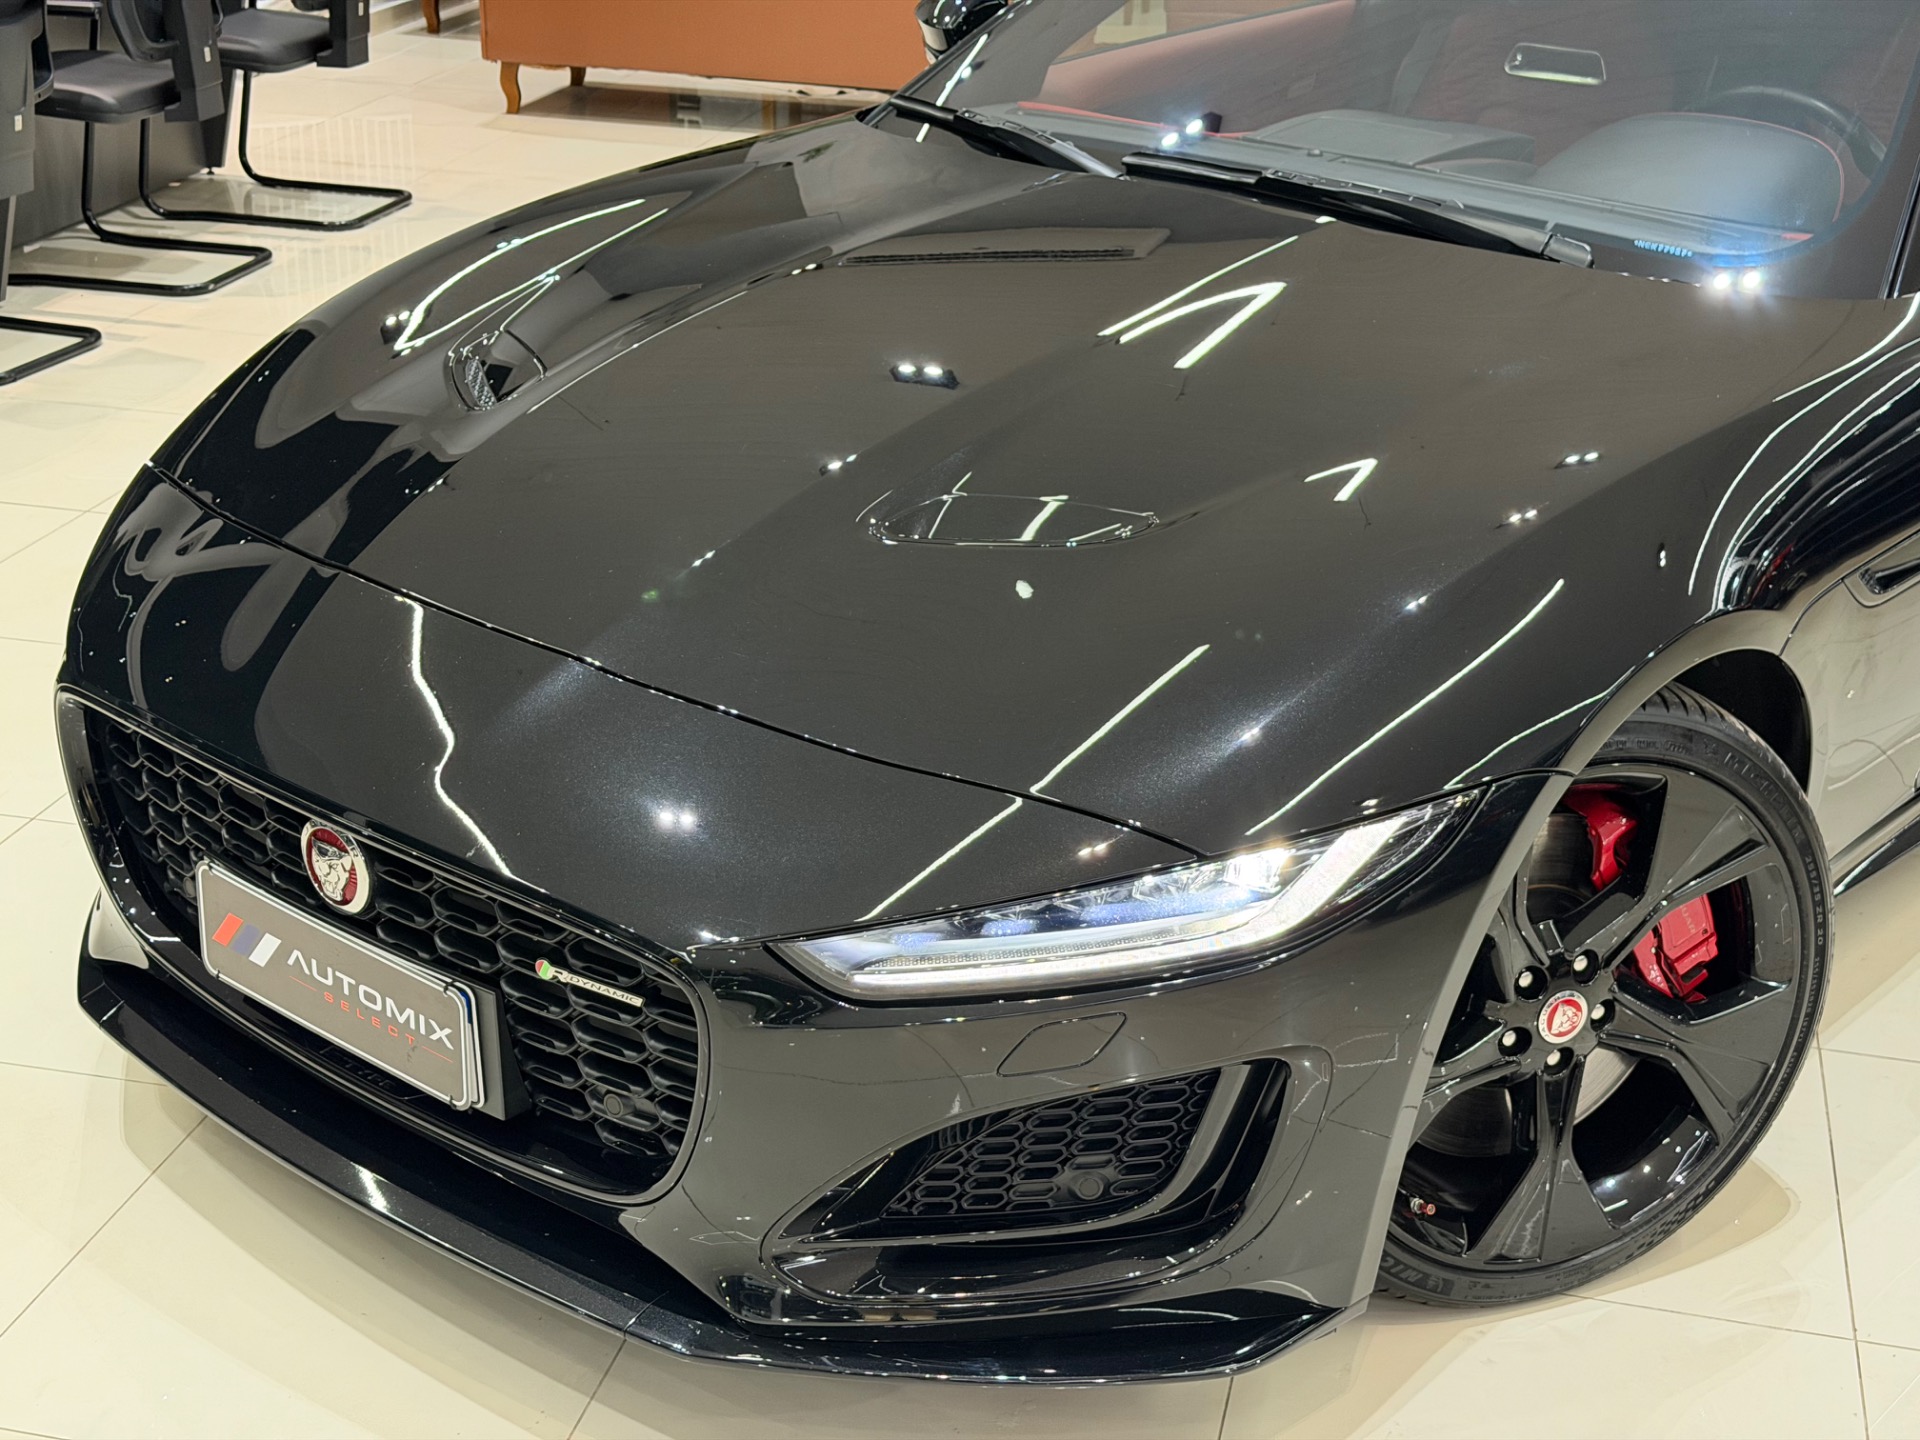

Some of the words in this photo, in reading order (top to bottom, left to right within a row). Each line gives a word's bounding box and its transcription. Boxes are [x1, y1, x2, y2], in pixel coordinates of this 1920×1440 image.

[1817, 928, 1824, 945] 20
[287, 949, 454, 1050] AUTOMIX
[323, 991, 416, 1046] SELECT
